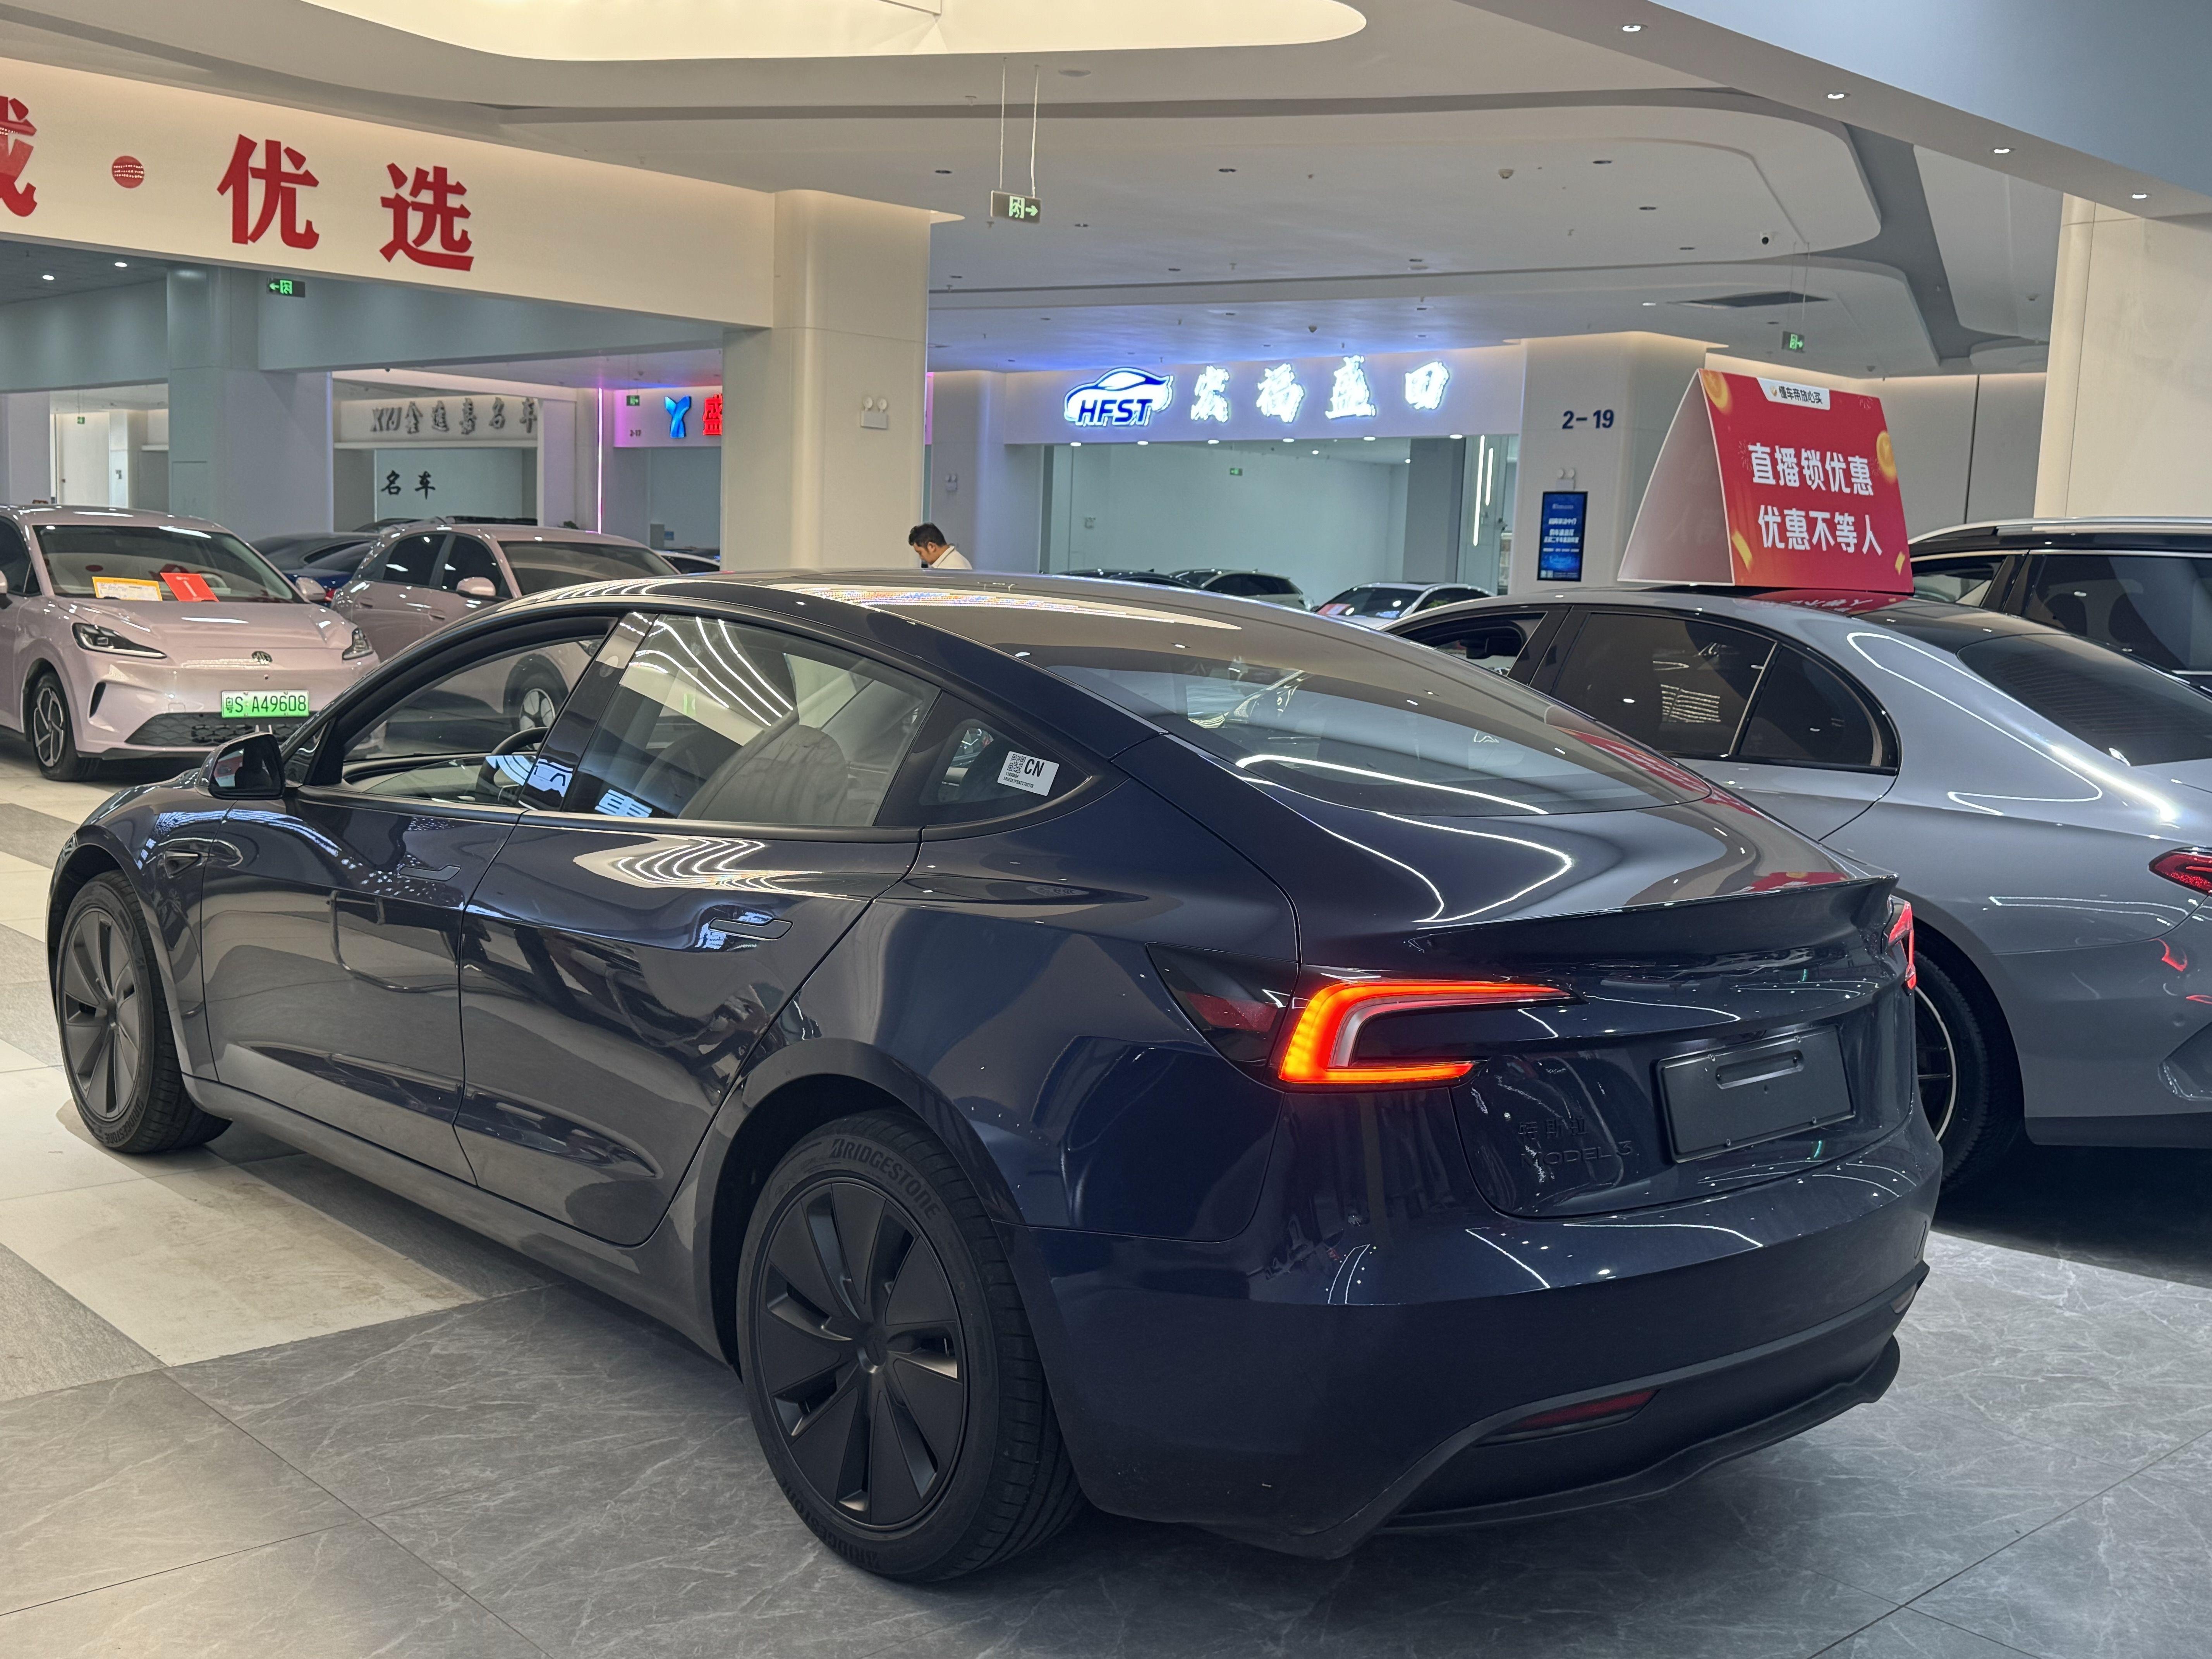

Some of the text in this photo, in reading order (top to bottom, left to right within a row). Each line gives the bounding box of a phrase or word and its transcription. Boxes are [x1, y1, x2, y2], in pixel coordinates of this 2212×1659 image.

[1779, 386, 1823, 405] 懂车帝放心买
[1078, 399, 1153, 425] HFST
[1562, 409, 1614, 429] 2-19
[1748, 442, 1874, 496] 直播锁优惠
[1758, 505, 1882, 556] 优惠不等人
[1024, 759, 1045, 777] CN
[1518, 1116, 1590, 1140] 特斯拉
[1520, 1140, 1633, 1168] MODEL 3
[829, 1138, 941, 1220] BRIDGESTONE
